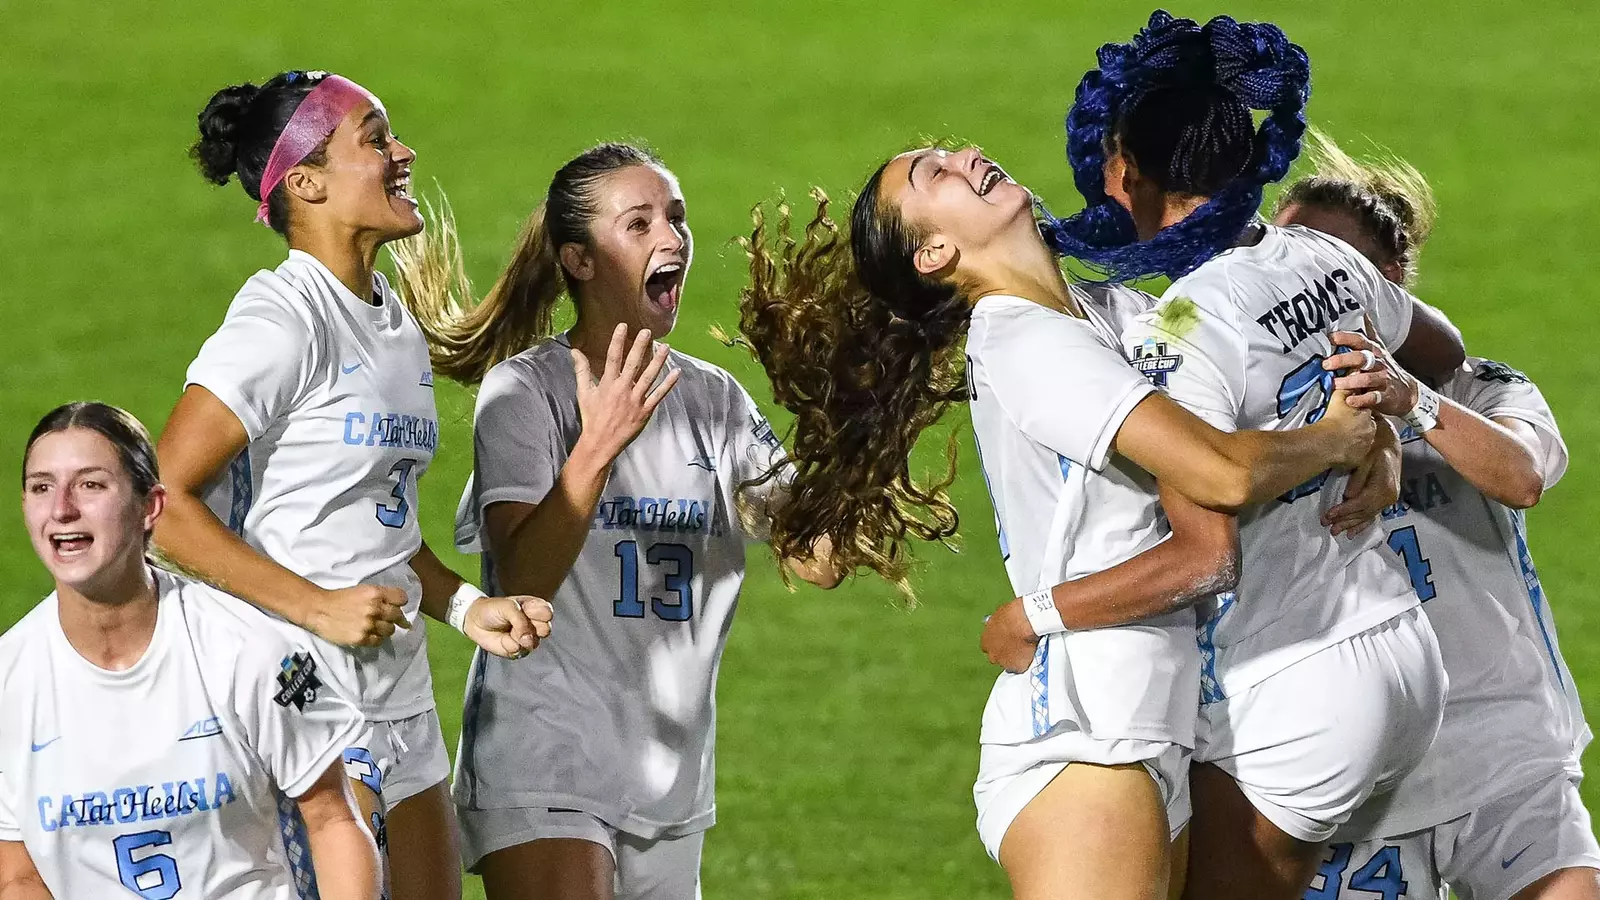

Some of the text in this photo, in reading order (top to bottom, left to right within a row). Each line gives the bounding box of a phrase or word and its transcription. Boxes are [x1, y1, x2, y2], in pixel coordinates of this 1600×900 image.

[1157, 358, 1176, 369] CUP
[376, 457, 418, 529] 3
[600, 500, 704, 531] Tar Heels
[613, 540, 694, 621] 13
[37, 772, 236, 832] CAROLINA
[69, 781, 199, 824] Tar Heels
[113, 829, 182, 900] 6
